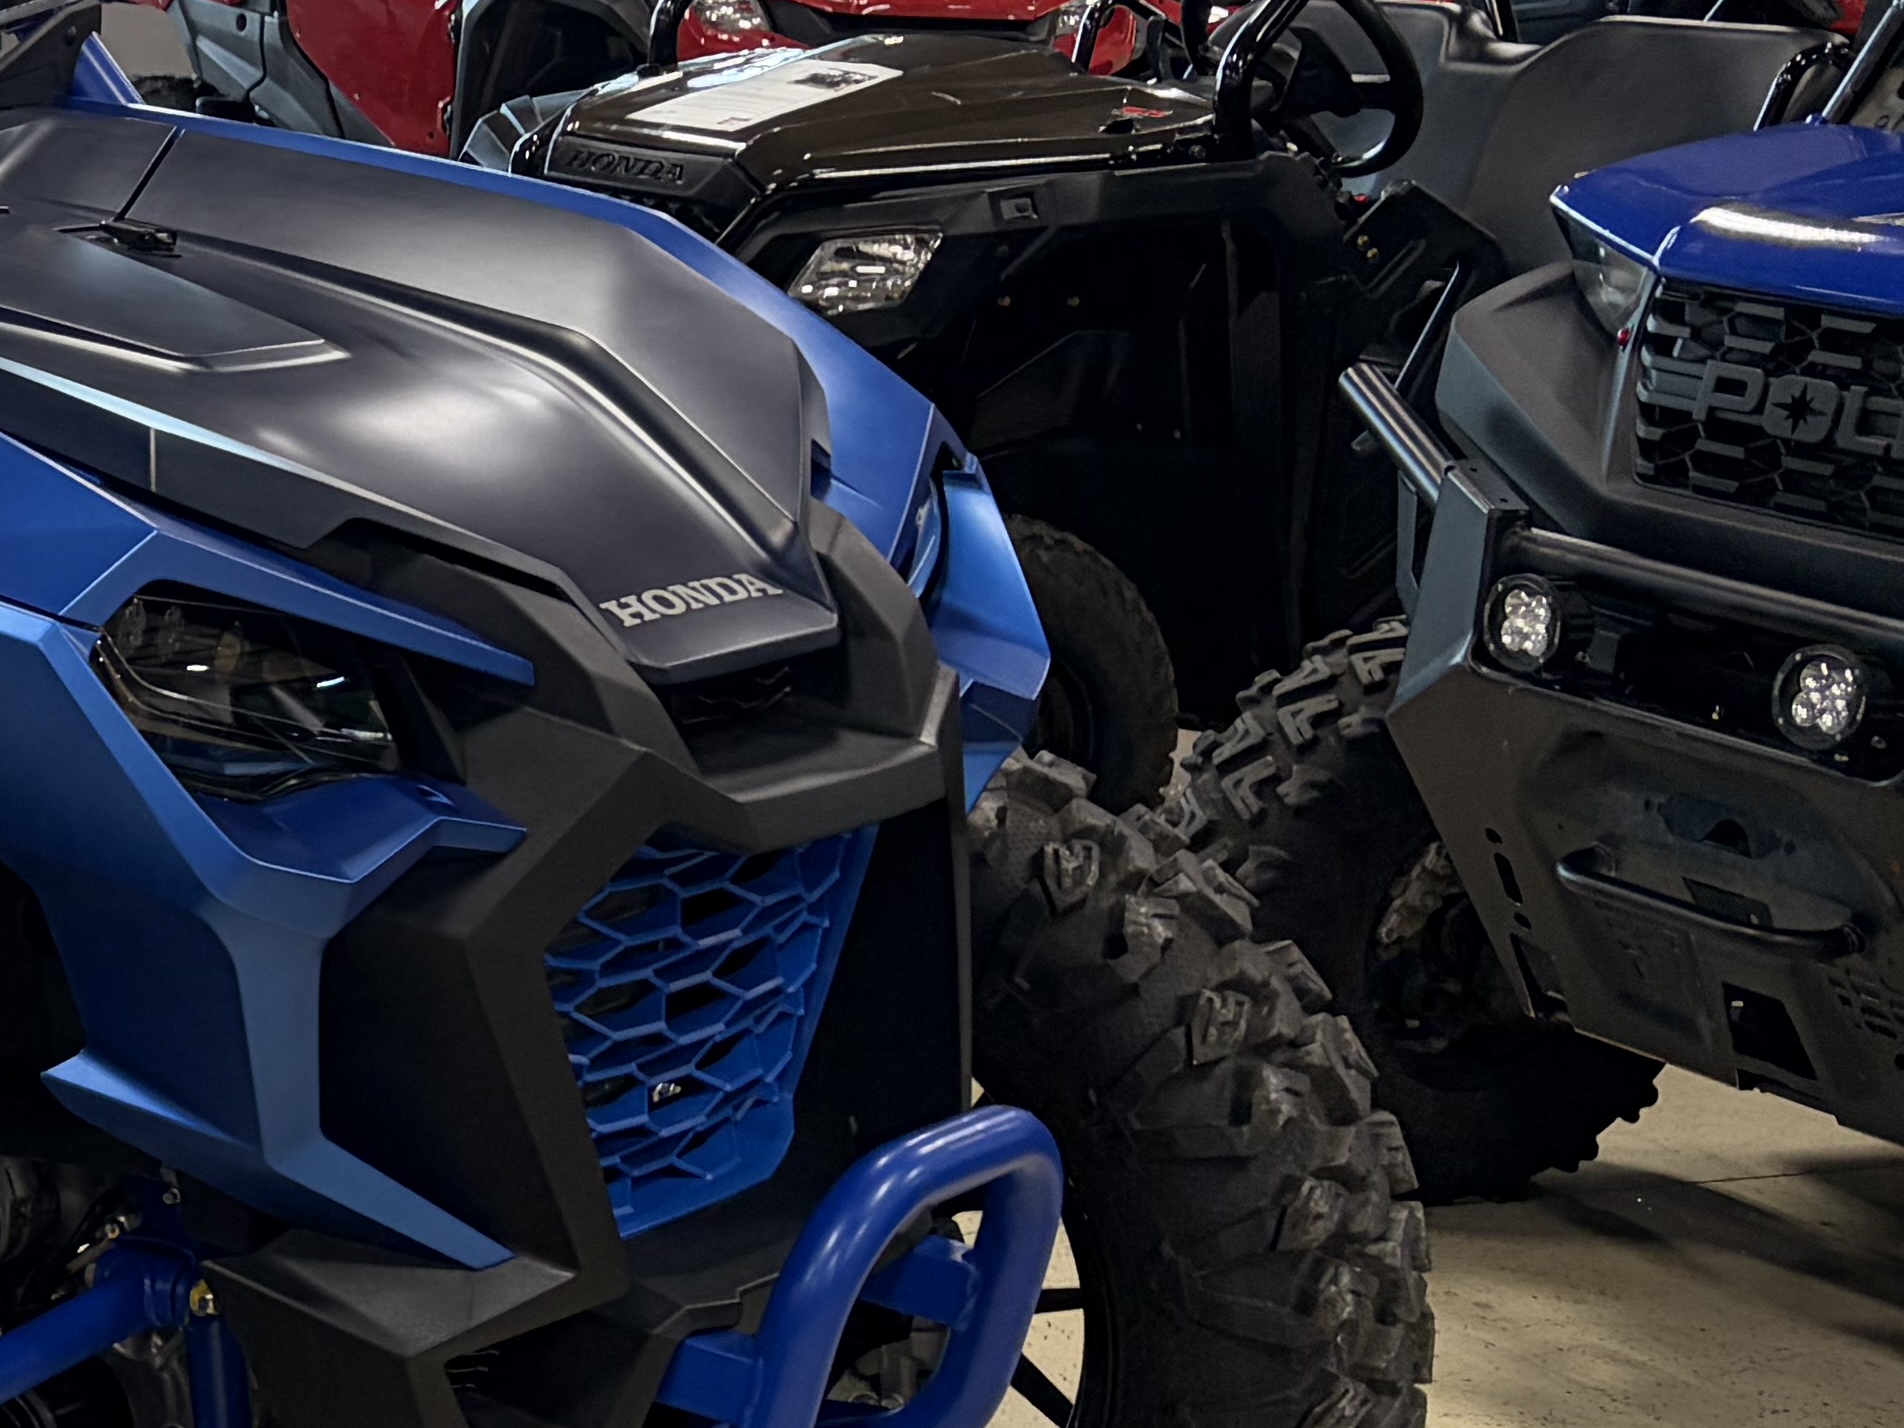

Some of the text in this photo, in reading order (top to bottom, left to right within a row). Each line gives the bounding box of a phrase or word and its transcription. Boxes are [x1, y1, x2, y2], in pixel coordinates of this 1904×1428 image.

[566, 148, 685, 184] HONDA
[1693, 359, 1904, 460] POL
[600, 573, 783, 629] HONDA
